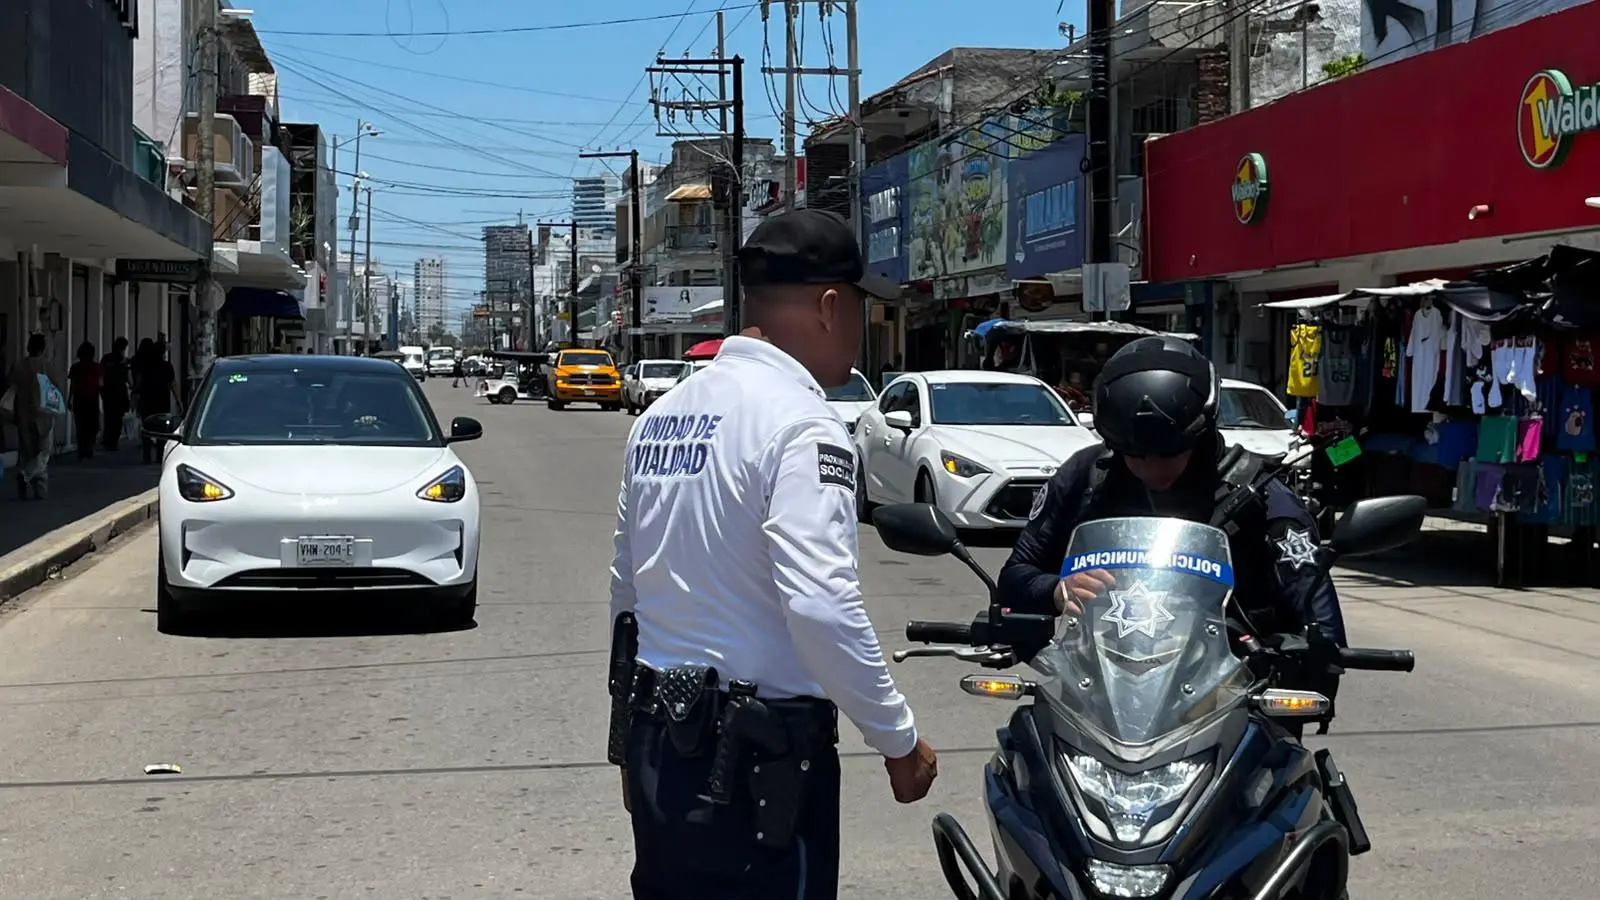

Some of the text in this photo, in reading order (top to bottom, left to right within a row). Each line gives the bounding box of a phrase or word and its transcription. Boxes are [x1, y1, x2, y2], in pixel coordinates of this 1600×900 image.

[1538, 85, 1600, 138] Wald
[640, 413, 723, 442] UNIDAD DE
[633, 442, 708, 476] VIALIDAD
